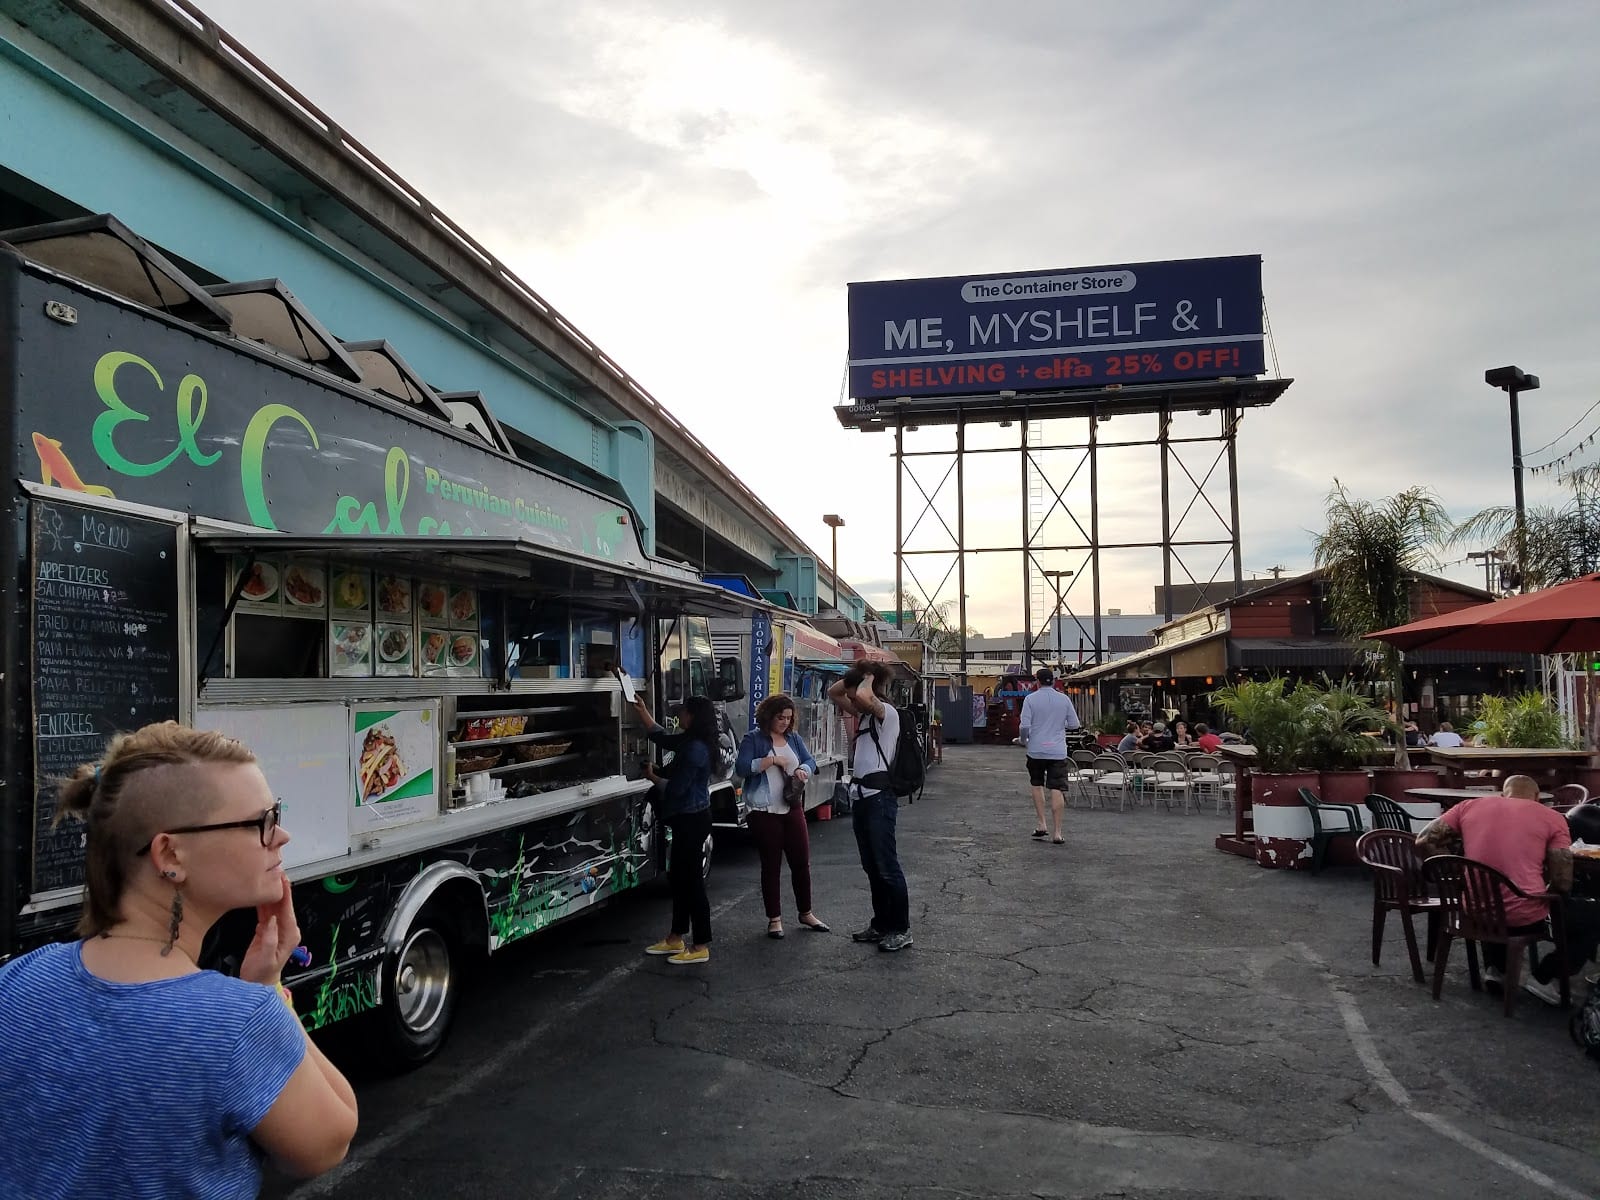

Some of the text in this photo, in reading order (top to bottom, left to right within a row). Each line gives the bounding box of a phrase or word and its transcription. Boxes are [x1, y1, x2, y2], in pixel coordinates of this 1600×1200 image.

[972, 284, 1000, 297] The
[1002, 278, 1079, 296] Container
[884, 297, 1223, 352] ME, MYSHELF & I
[872, 363, 1006, 389] SHELVING
[1034, 357, 1093, 380] elfa
[1105, 353, 1163, 376] 25%
[1173, 348, 1240, 371] OFF!
[91, 351, 223, 477] El
[424, 466, 569, 533] Peruvian Cuisine
[39, 561, 109, 585] APPETIZERS
[38, 614, 69, 631] FRIED
[755, 621, 765, 671] TORTAS
[38, 712, 94, 736] ENTREES
[38, 737, 107, 752] FISH CEVICH
